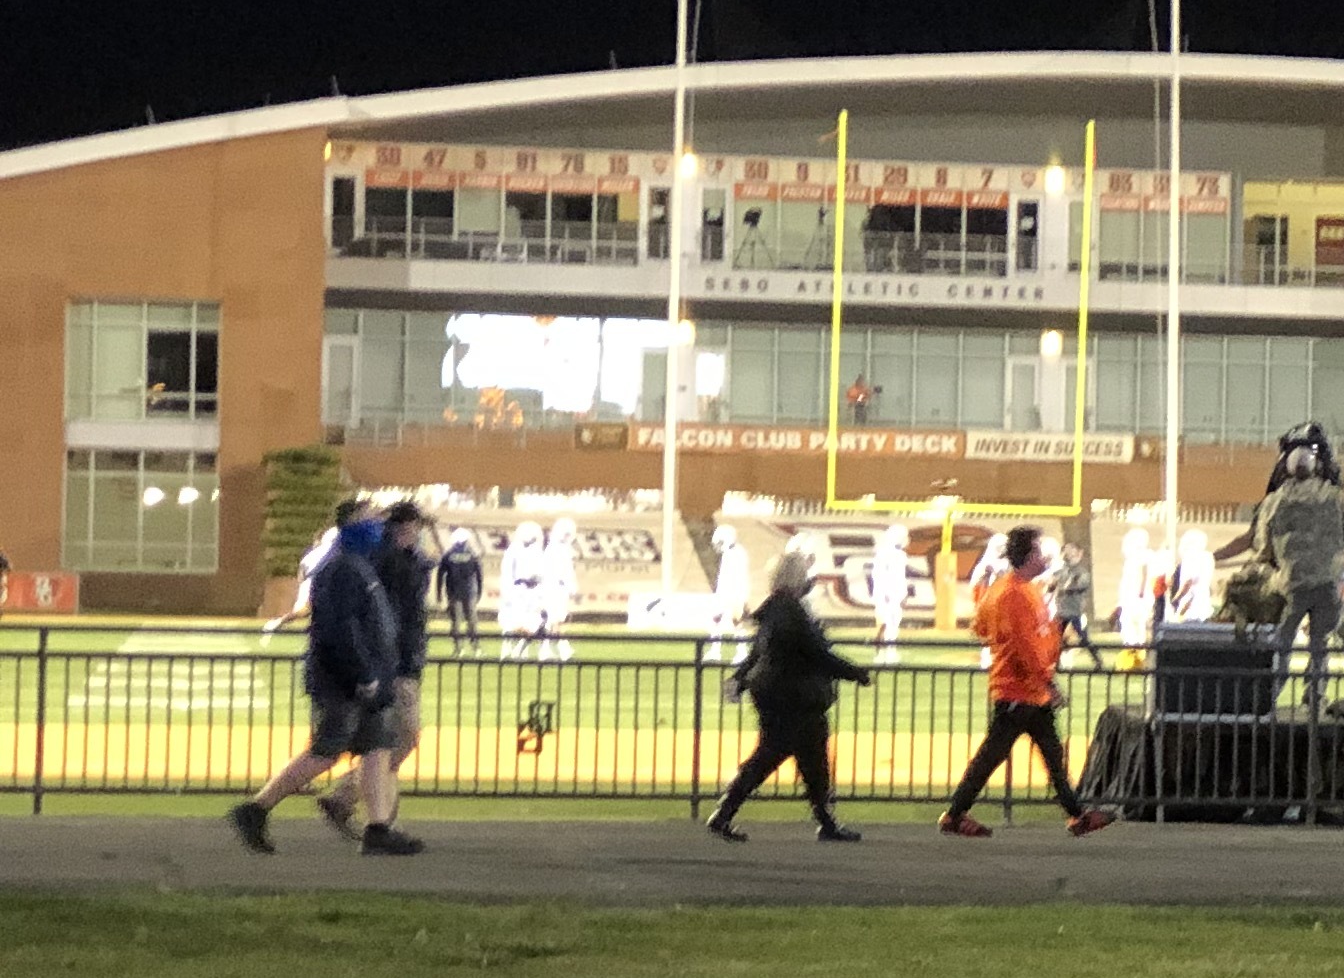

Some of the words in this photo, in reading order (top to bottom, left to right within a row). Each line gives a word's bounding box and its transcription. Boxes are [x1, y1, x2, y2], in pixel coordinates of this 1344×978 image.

[423, 148, 448, 169] 47
[705, 277, 769, 294] SEBO
[797, 280, 920, 298] ATLETIC
[947, 284, 1044, 302] CENTER
[637, 428, 734, 449] FACON
[740, 430, 802, 451] CLUB
[895, 433, 959, 454] DECK
[974, 440, 1028, 456] INVEST
[1033, 442, 1050, 456] IN
[1054, 442, 1125, 458] SUCESS
